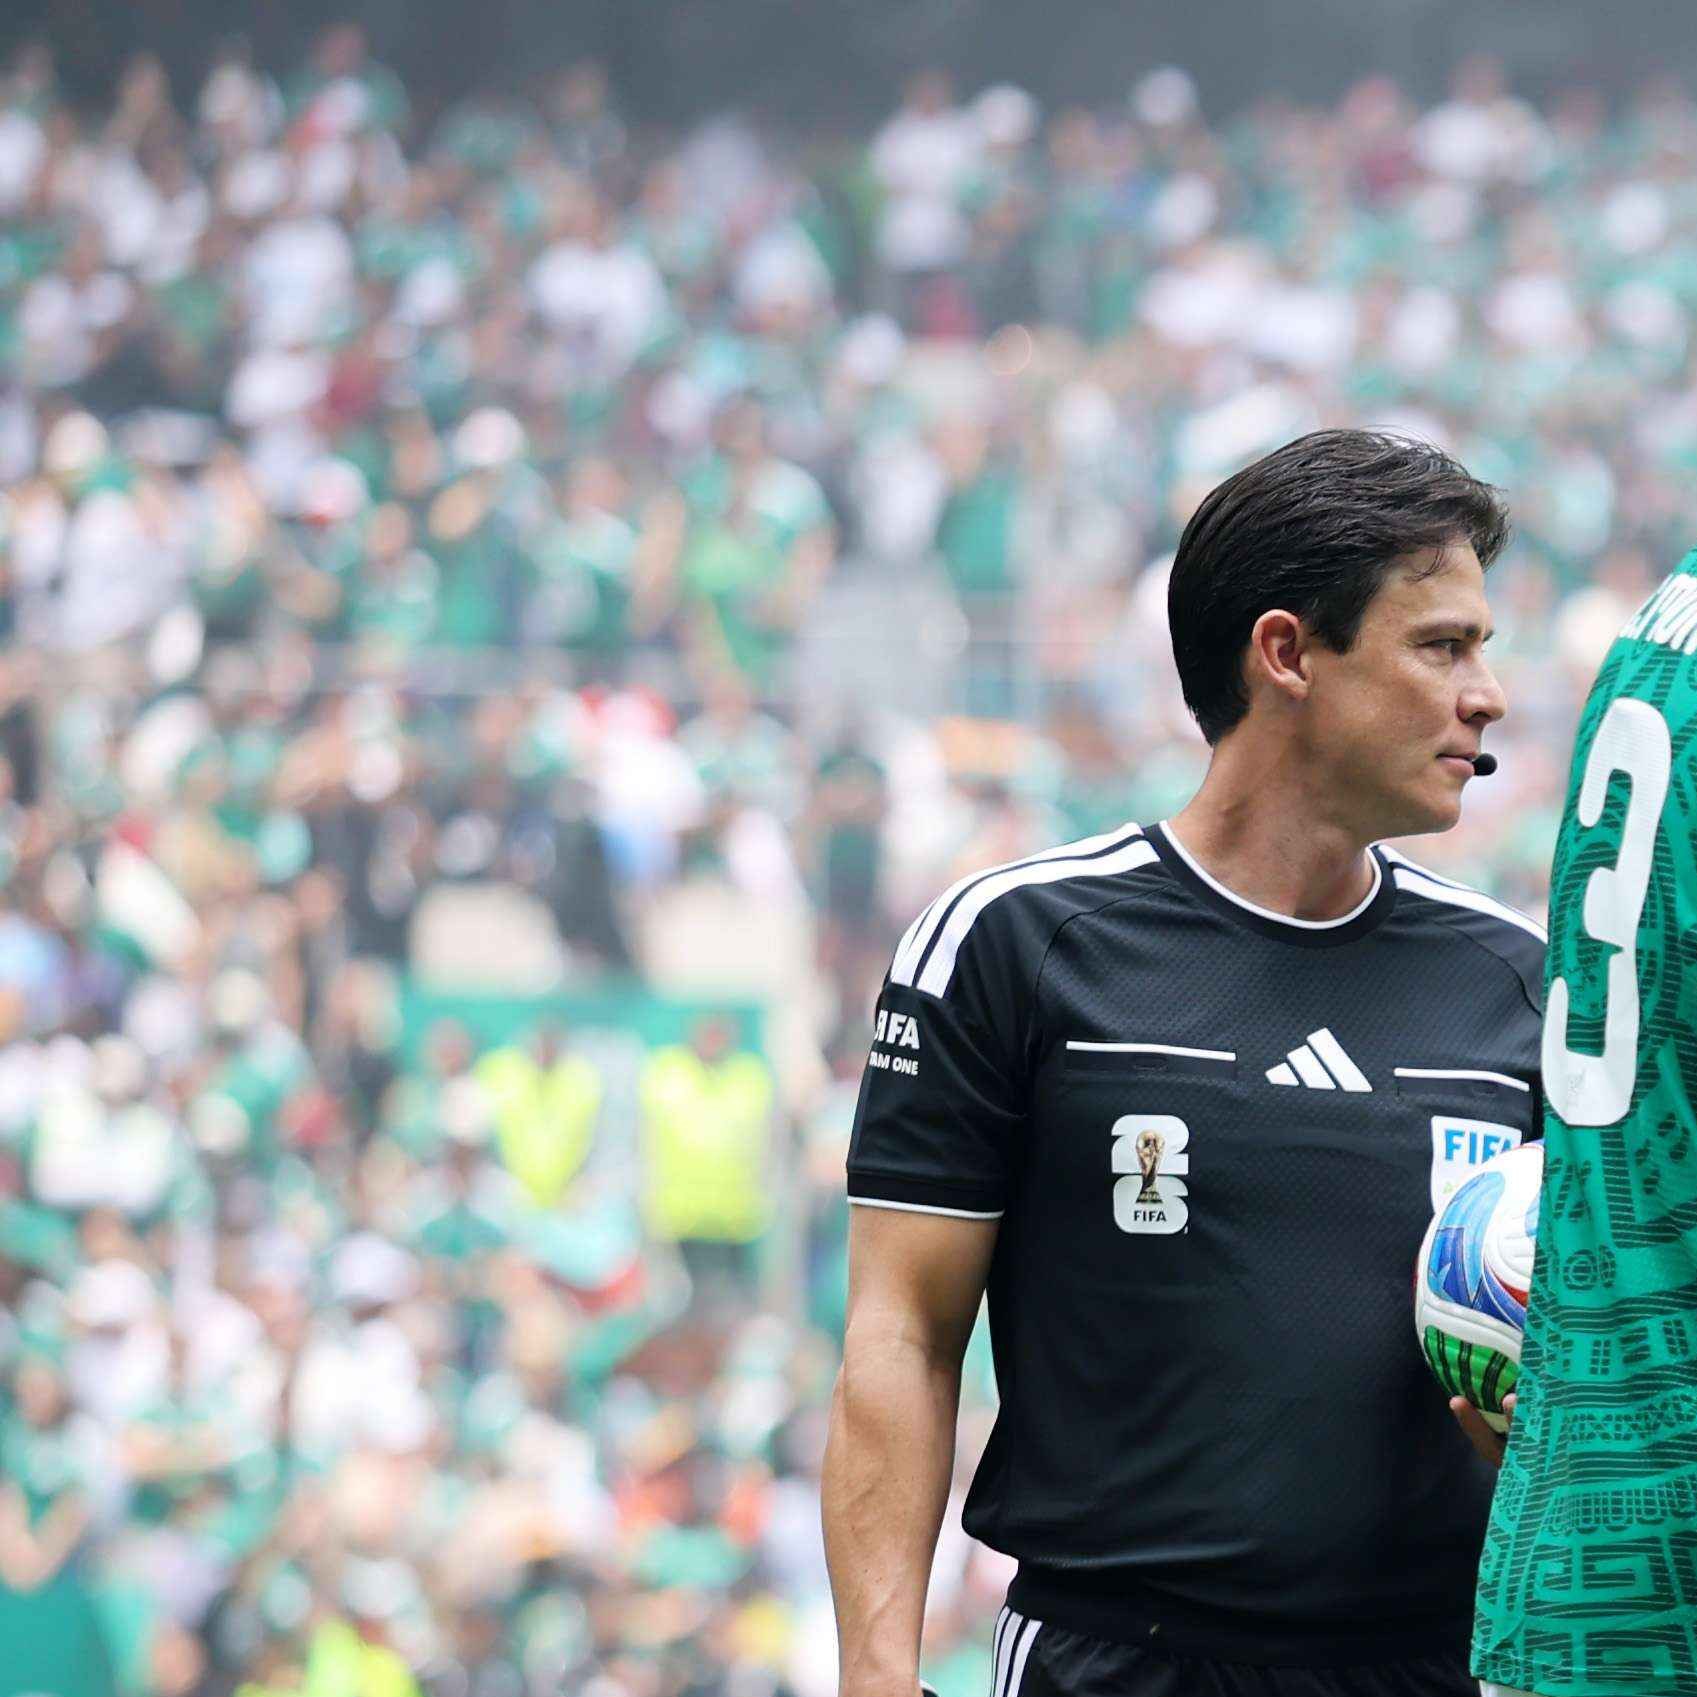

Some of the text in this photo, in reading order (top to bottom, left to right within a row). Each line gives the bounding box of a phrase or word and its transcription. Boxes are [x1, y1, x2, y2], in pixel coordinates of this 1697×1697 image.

[1541, 698, 1672, 1127] 3
[892, 1056, 919, 1076] ONE
[1133, 1210, 1167, 1222] FIFA
